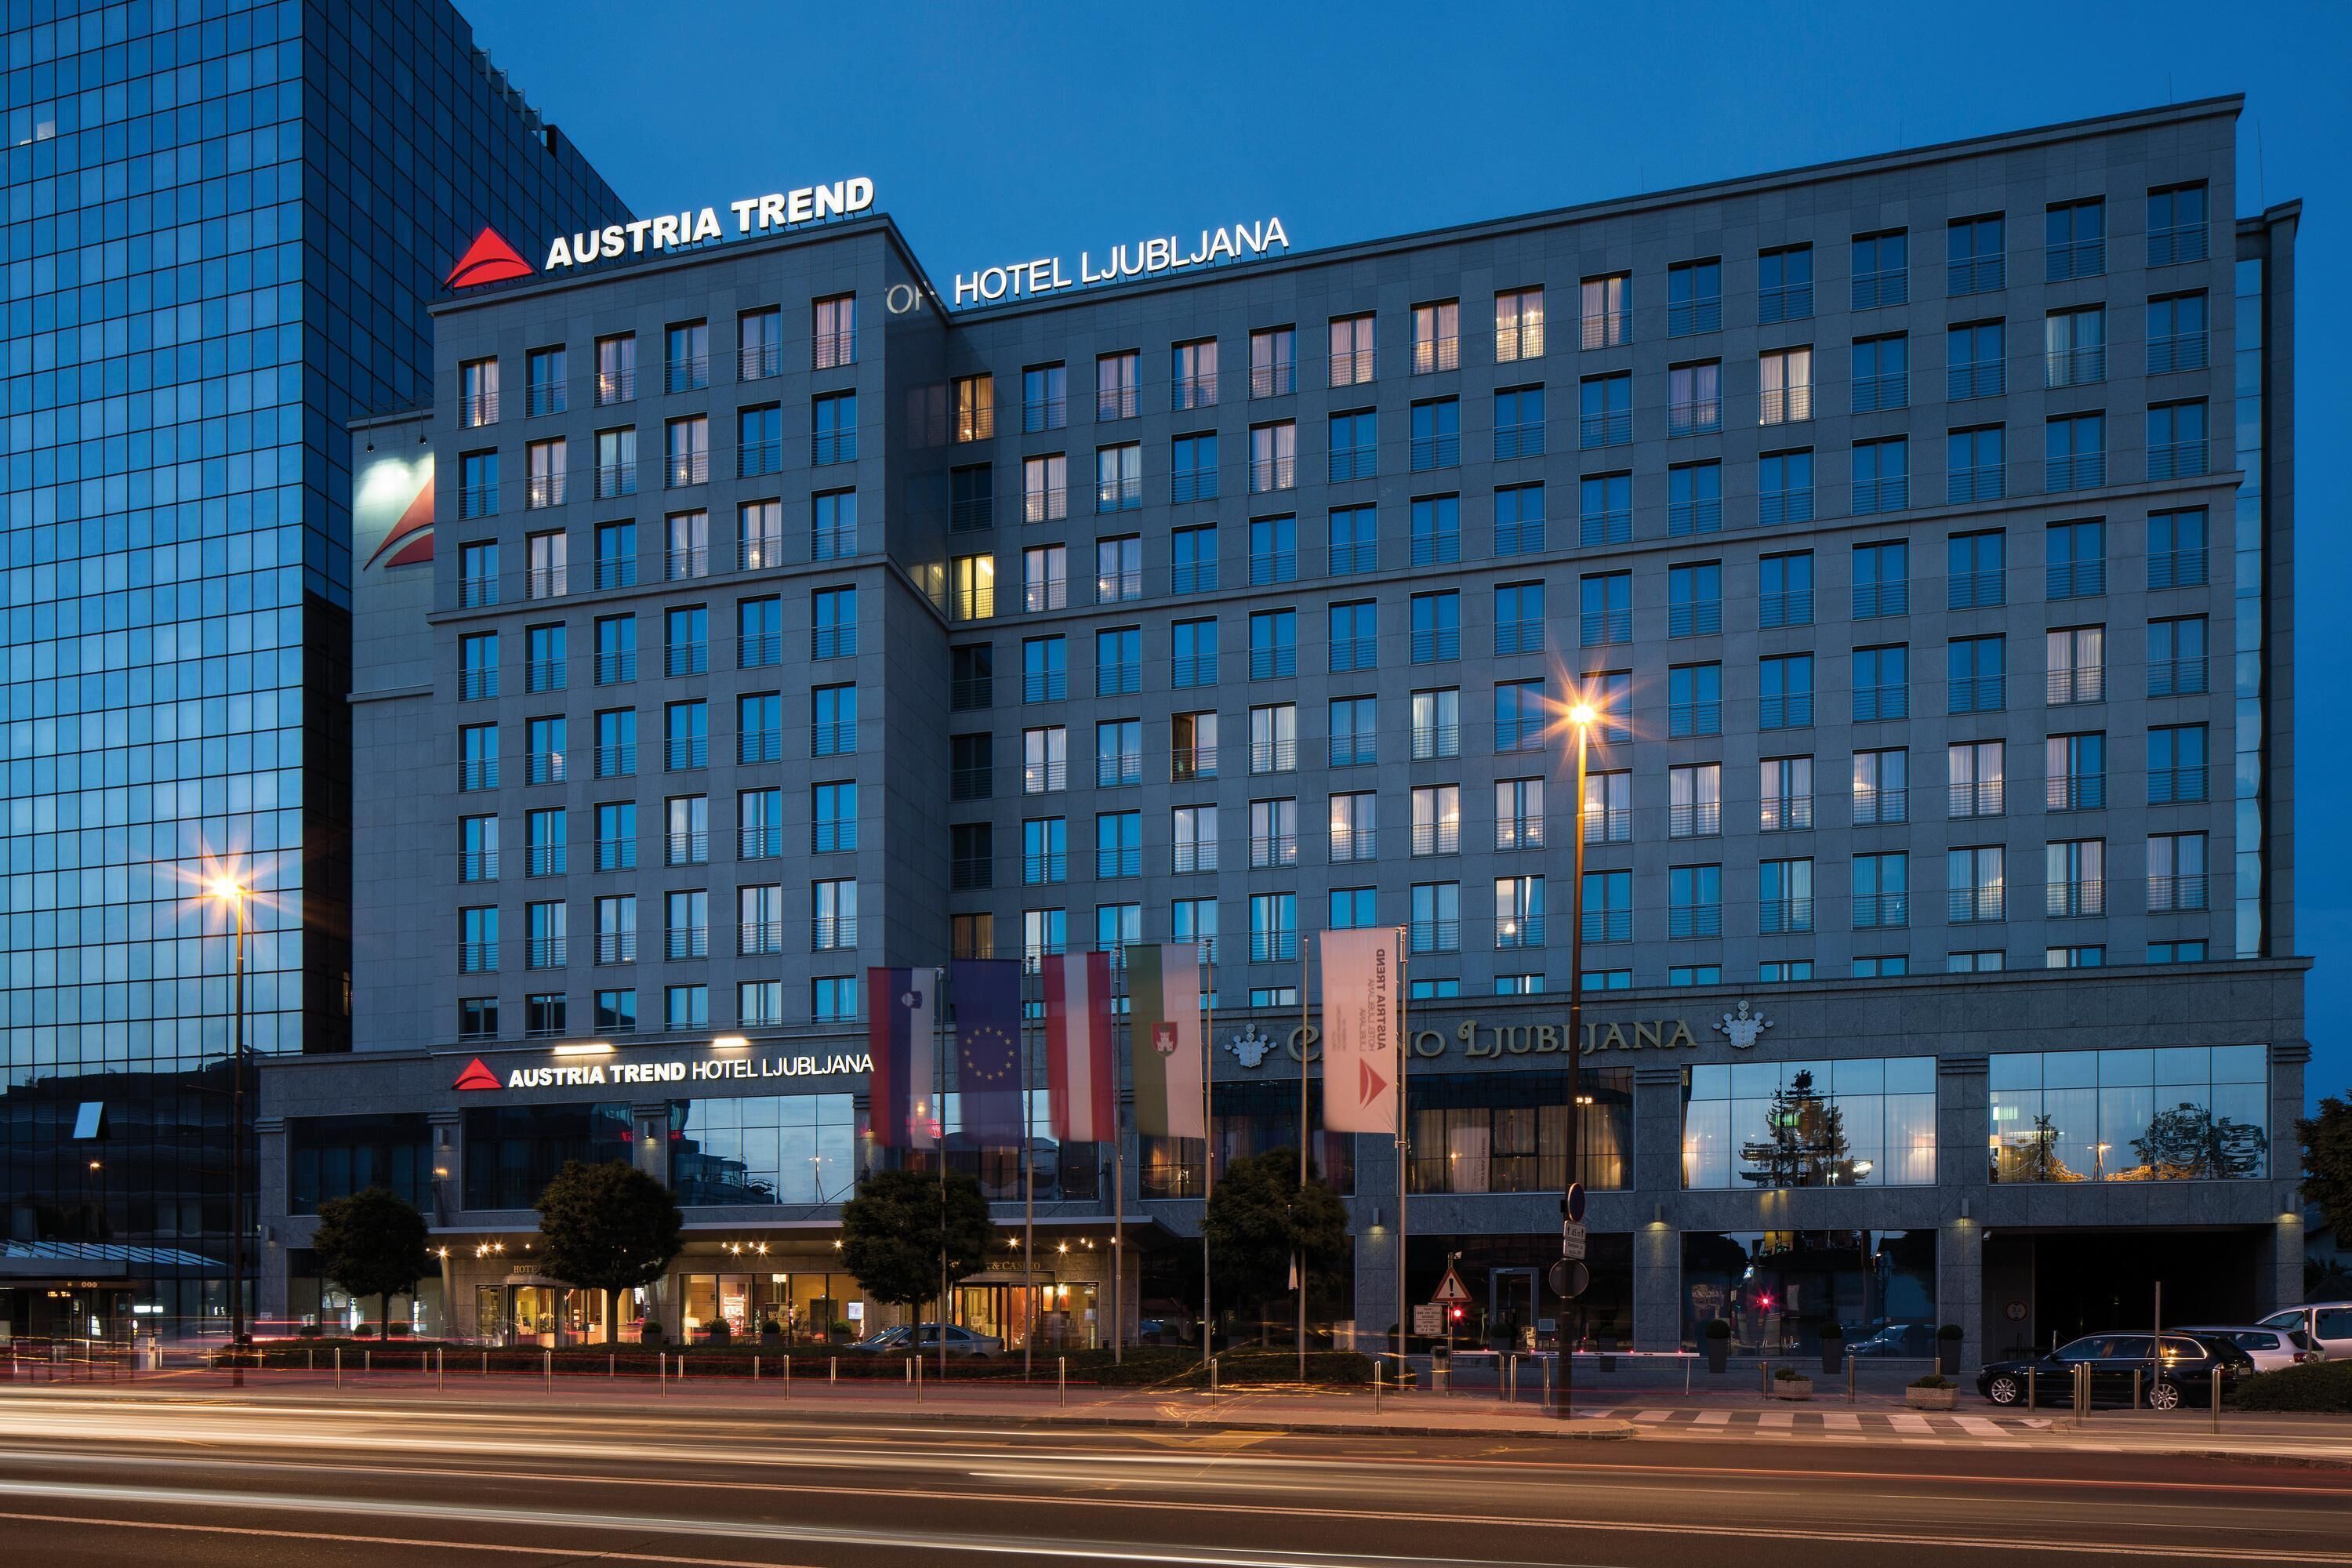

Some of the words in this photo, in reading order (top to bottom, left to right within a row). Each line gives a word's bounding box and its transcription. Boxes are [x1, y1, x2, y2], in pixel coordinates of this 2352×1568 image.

[545, 207, 723, 270] AUSTRIA
[731, 177, 874, 232] TREND
[955, 257, 1072, 305] HOTEL
[1082, 217, 1290, 283] LJUBLJANA
[508, 1066, 605, 1088] AUSTRIA
[609, 1062, 686, 1083] TREND
[692, 1058, 759, 1080] HOTEL
[762, 1054, 874, 1077] LJUBLJANA
[514, 1265, 540, 1274] HOTE
[1002, 1261, 1040, 1270] CASIO
